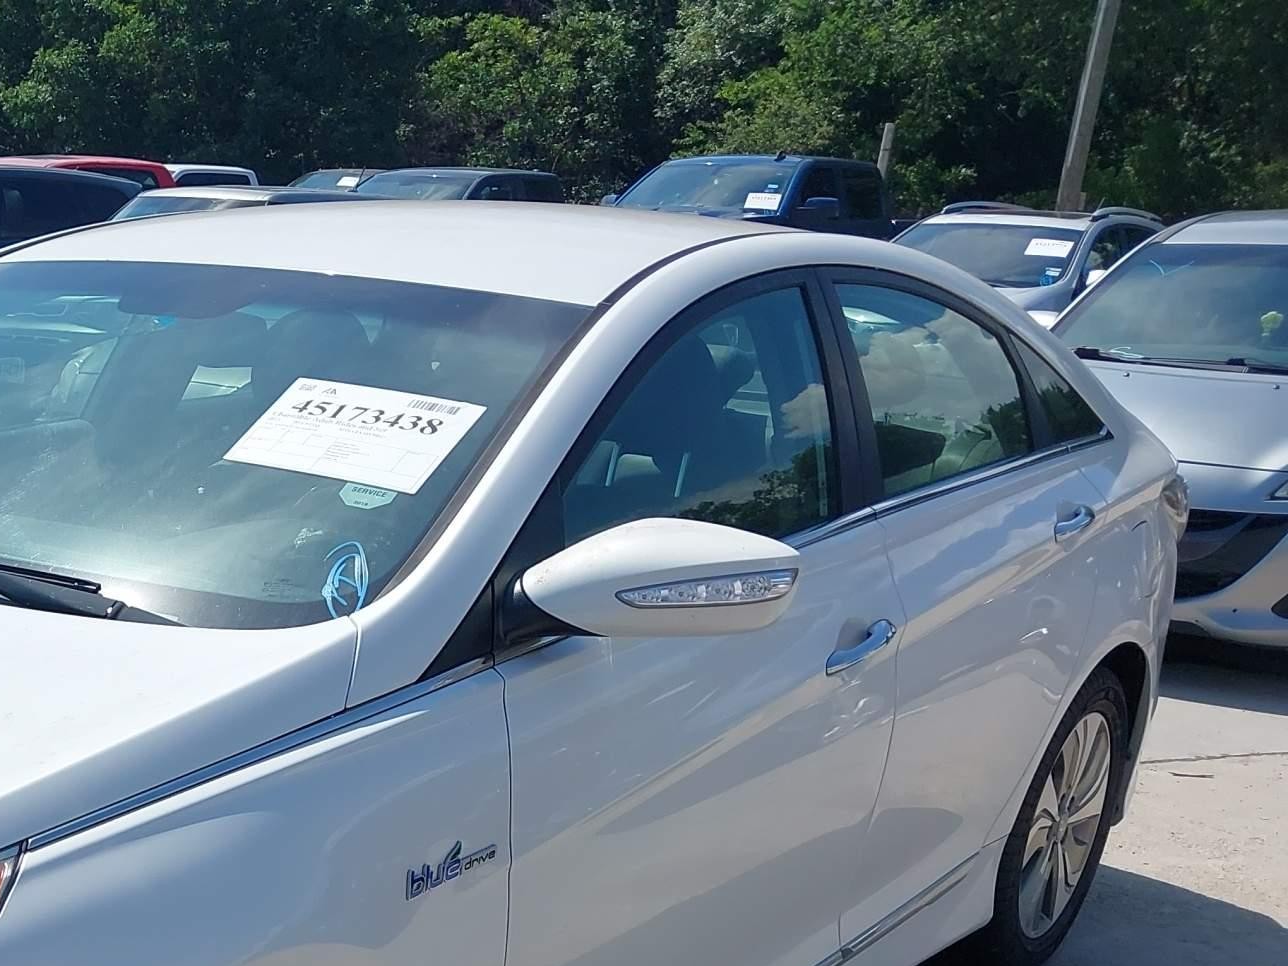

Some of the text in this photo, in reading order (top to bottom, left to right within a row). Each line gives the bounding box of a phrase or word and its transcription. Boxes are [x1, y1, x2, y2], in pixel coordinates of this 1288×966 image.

[291, 399, 444, 435] 45173438
[352, 486, 388, 498] SERVICE
[464, 849, 496, 871] drive
